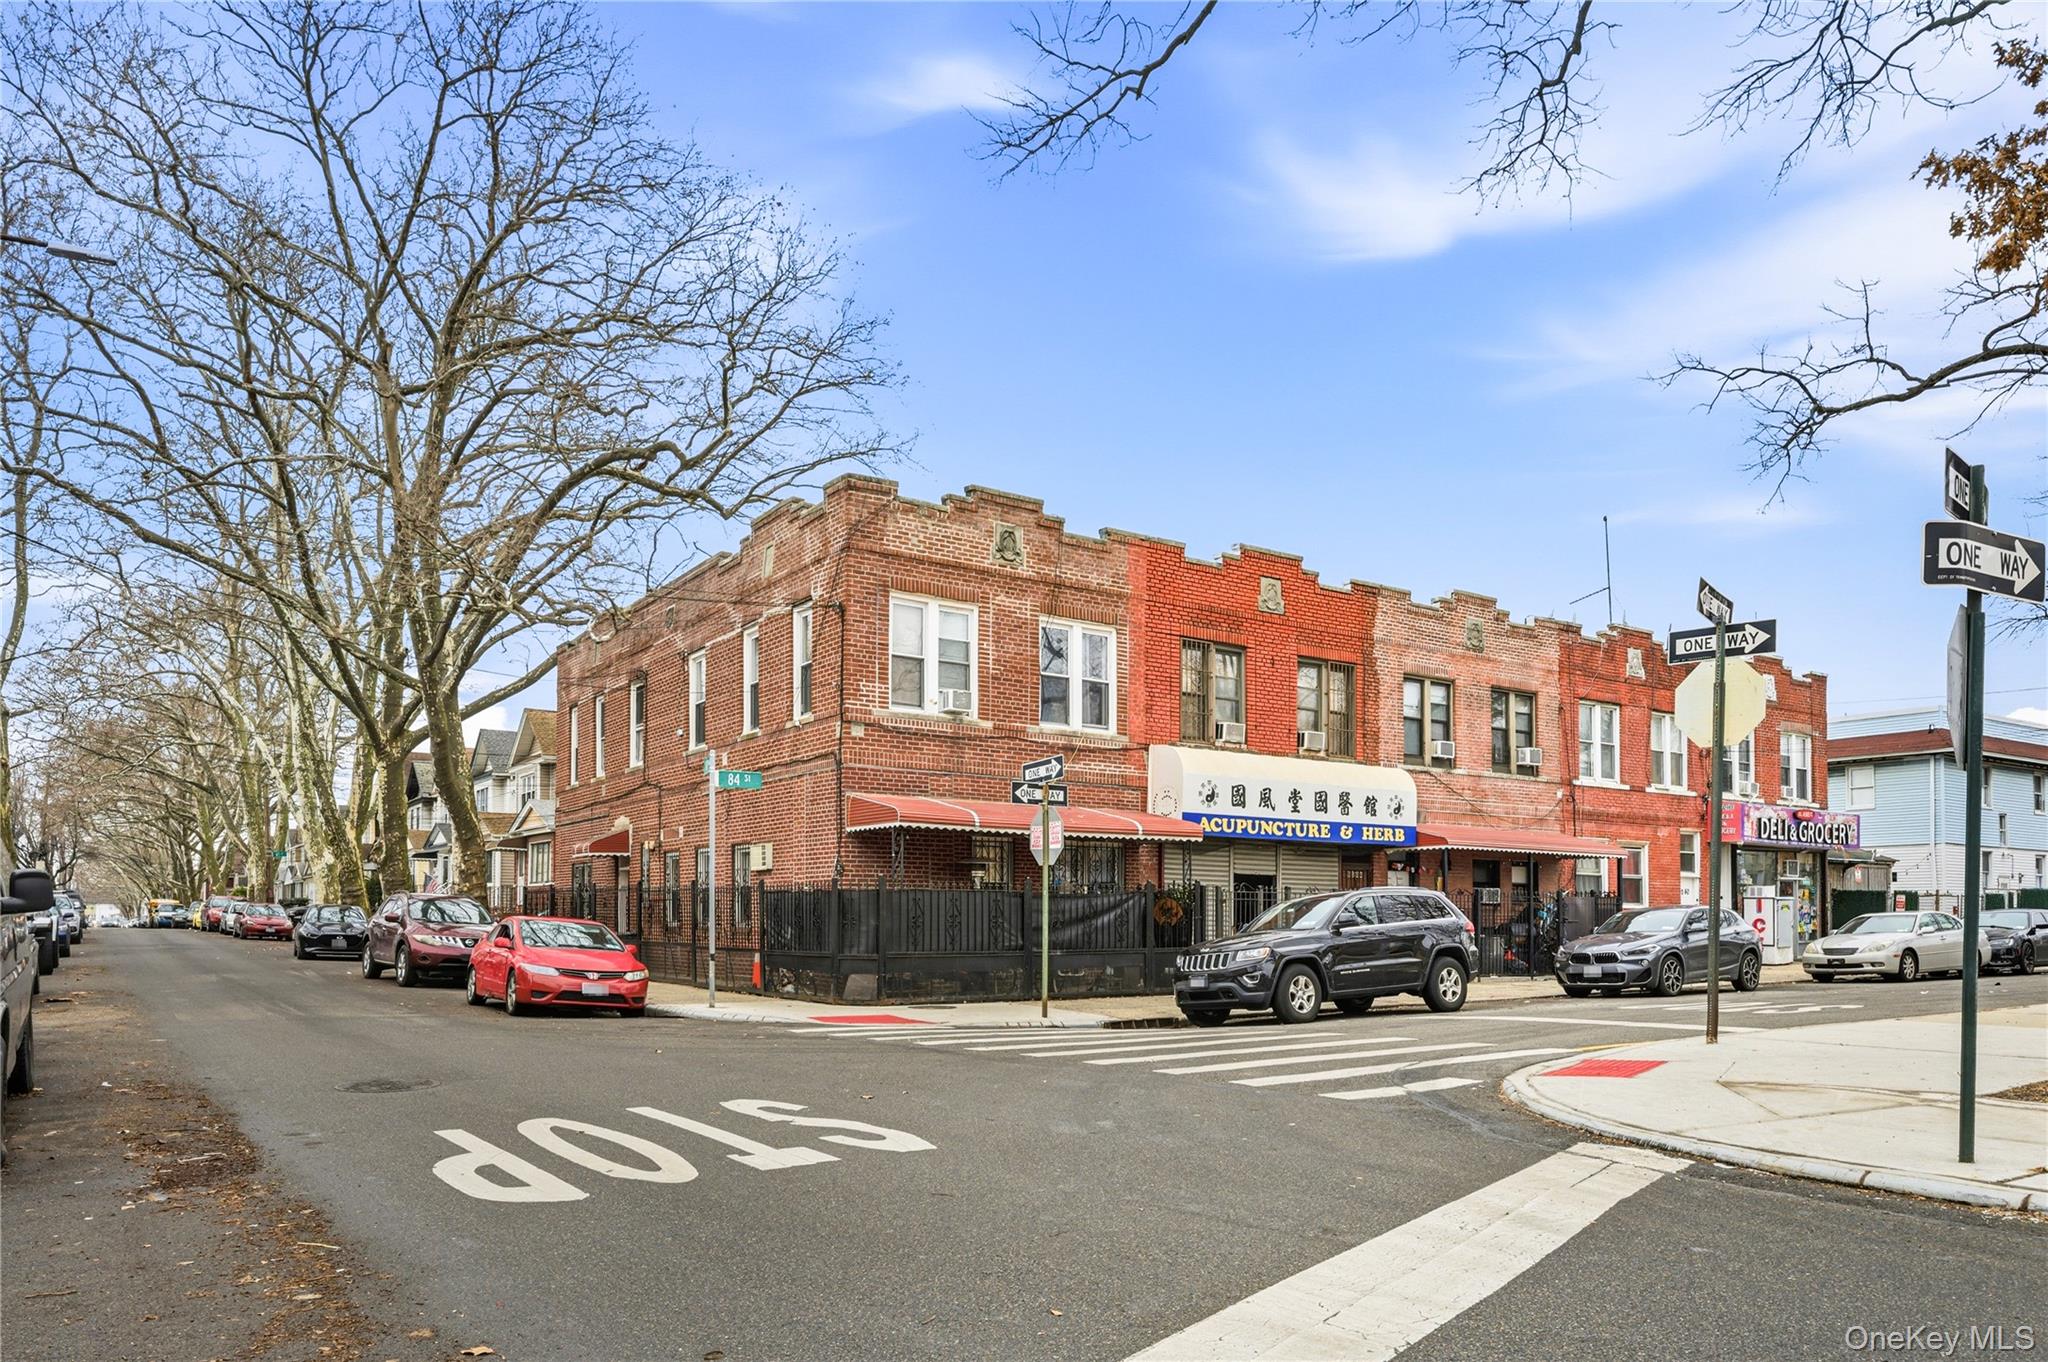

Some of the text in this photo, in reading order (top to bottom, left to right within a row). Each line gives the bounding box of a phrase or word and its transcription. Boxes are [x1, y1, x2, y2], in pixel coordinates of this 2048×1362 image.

[1954, 474, 1969, 507] ONE
[1946, 541, 2029, 580] ONE WAY
[1684, 632, 1760, 653] ONE WAY
[728, 773, 740, 786] 84
[1028, 764, 1058, 779] ONE WAY
[1020, 789, 1061, 800] ONE AY
[1231, 784, 1379, 817] 國風堂國醫館
[1200, 816, 1406, 842] ACUPUNCTURE & HERB
[1760, 818, 1789, 841] DELI
[1789, 825, 1798, 841] &
[1799, 820, 1854, 846] GROCERY
[433, 1099, 938, 1202] STOP
